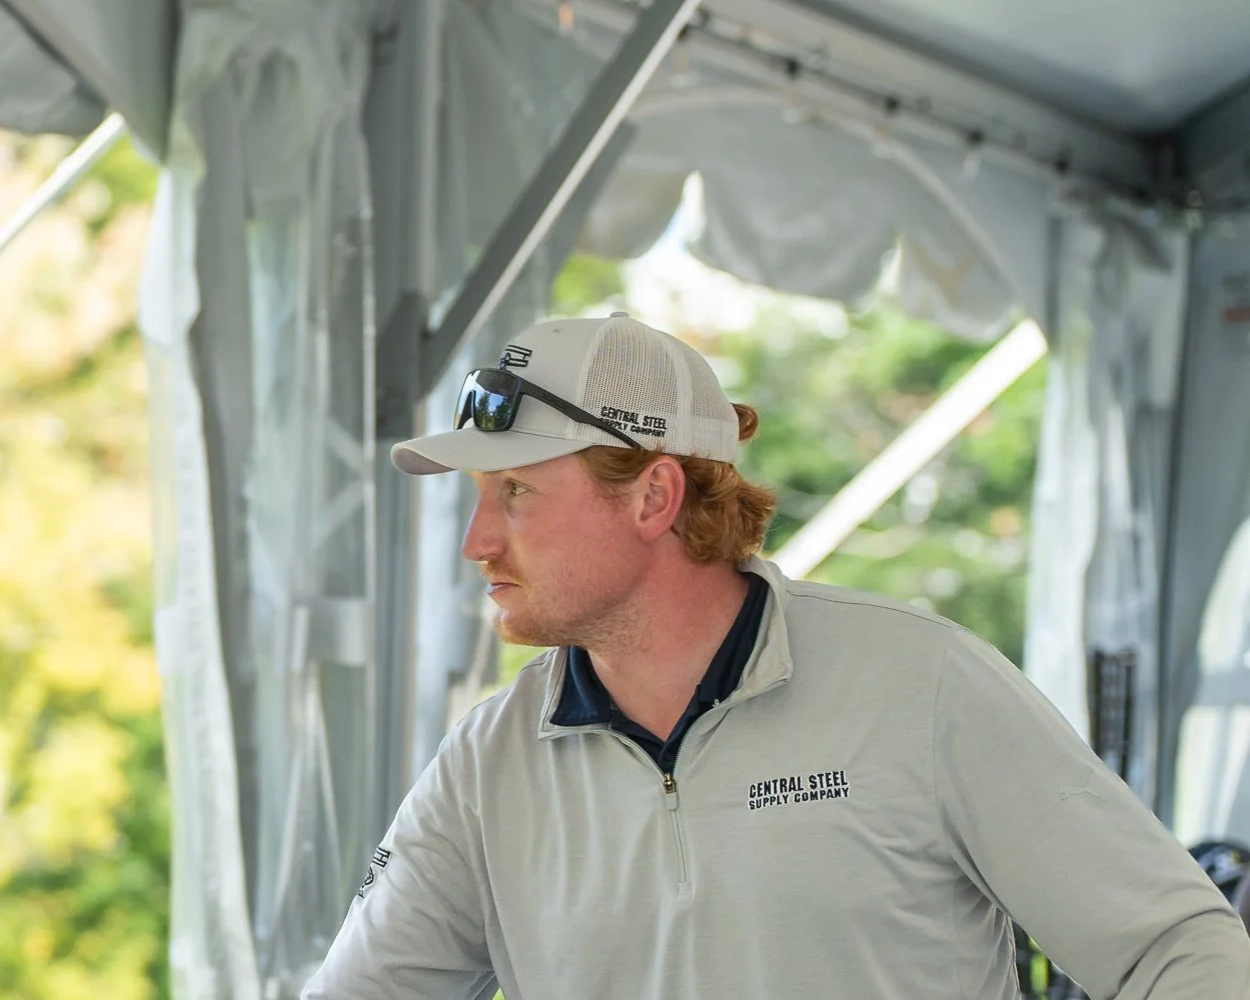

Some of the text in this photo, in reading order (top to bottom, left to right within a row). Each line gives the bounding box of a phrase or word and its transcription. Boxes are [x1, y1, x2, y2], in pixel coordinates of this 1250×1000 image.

[601, 406, 667, 430] CENTRAL STEEL
[631, 425, 666, 438] COMPANY
[750, 771, 848, 798] CENTRAL STEEL
[749, 787, 850, 811] SUPPLY COMPANY
